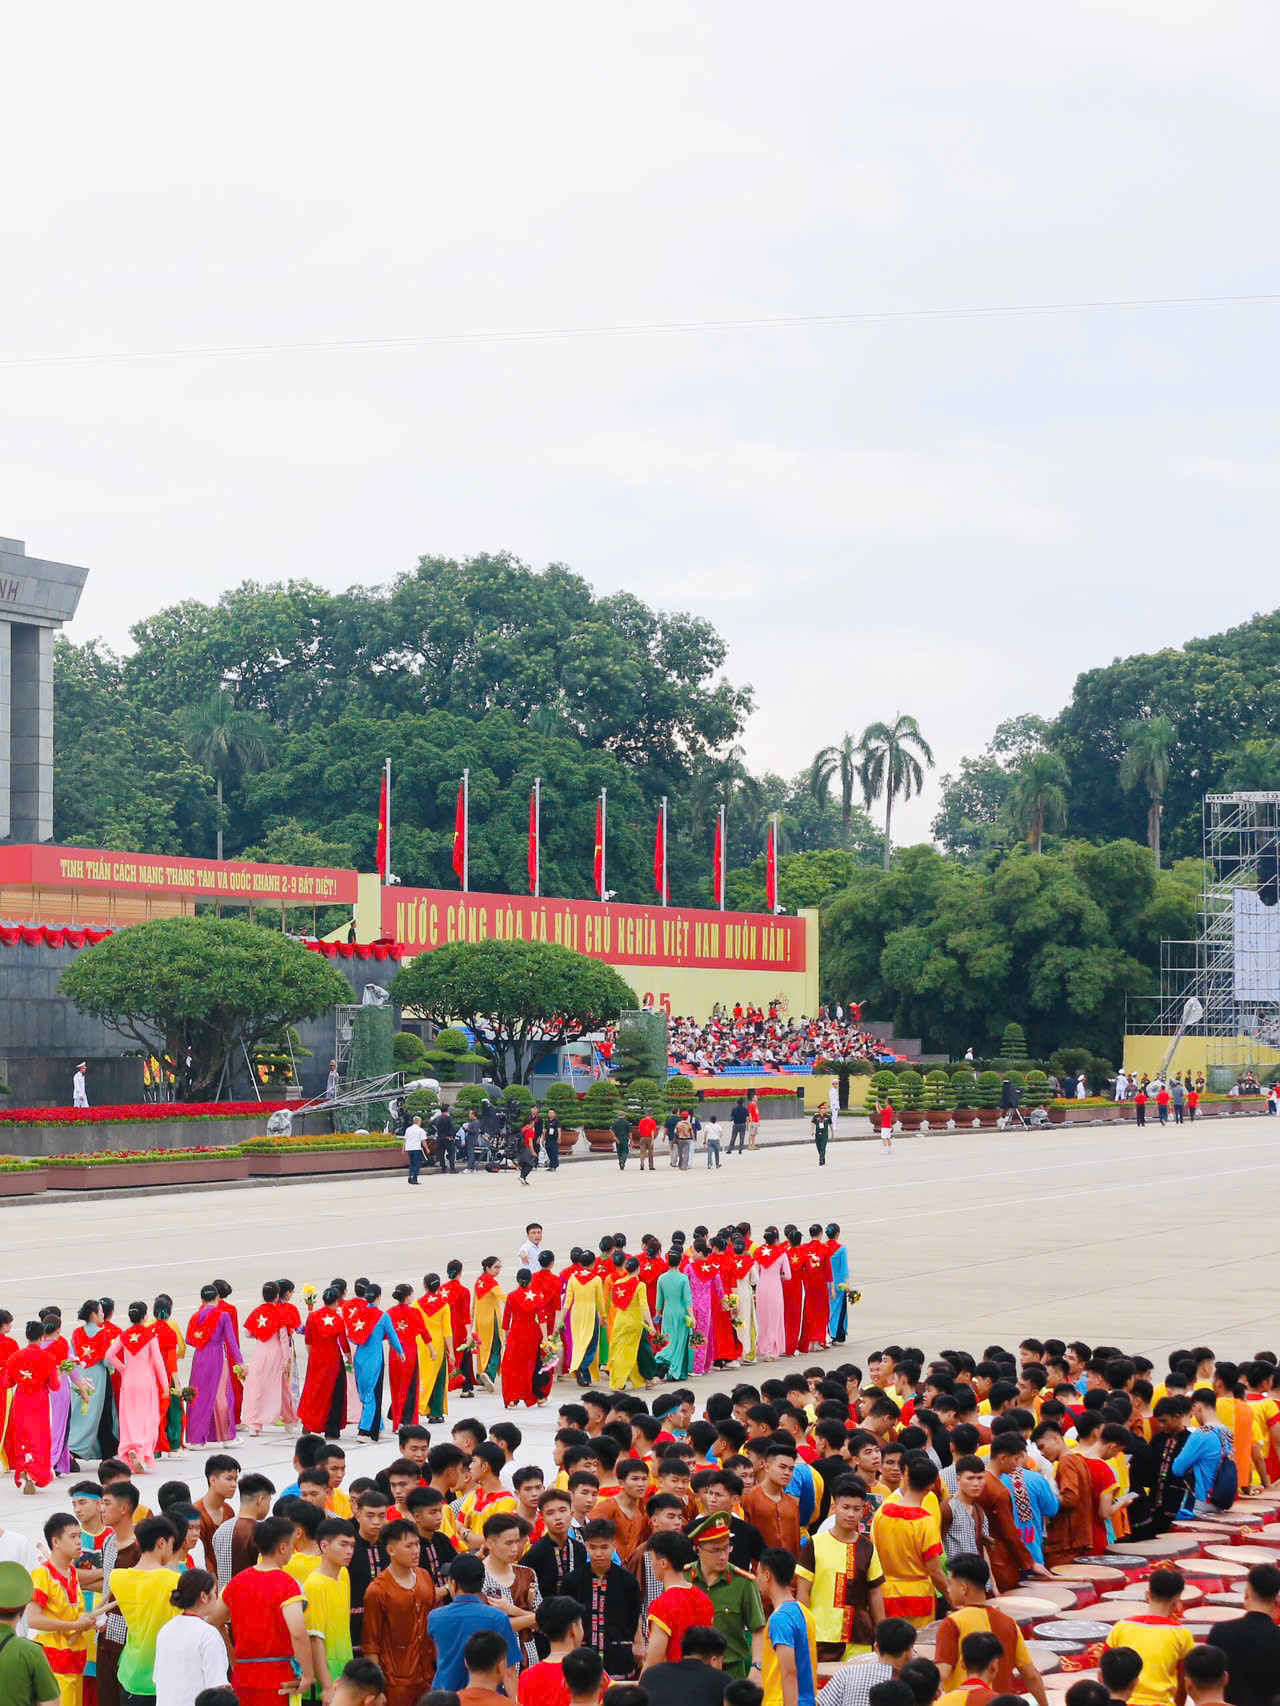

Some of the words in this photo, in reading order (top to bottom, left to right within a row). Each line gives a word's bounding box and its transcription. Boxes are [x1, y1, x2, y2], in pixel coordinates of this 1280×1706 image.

[60, 859, 84, 878] TINH
[113, 860, 137, 882] CÁCH
[139, 865, 164, 887] MẠNG
[166, 864, 194, 887] THÁNG
[197, 866, 215, 888] TÁM
[217, 868, 228, 889] VÀ
[230, 868, 251, 890] QUỐC
[253, 872, 280, 892] KHÁNH
[298, 872, 314, 894] BẤT
[396, 896, 438, 946] NƯỚC
[585, 907, 611, 953] CHỦ
[618, 913, 657, 956] NGHĨA
[663, 915, 689, 963] VIỆT
[695, 922, 720, 959] NAM
[725, 919, 756, 960] MUÔN
